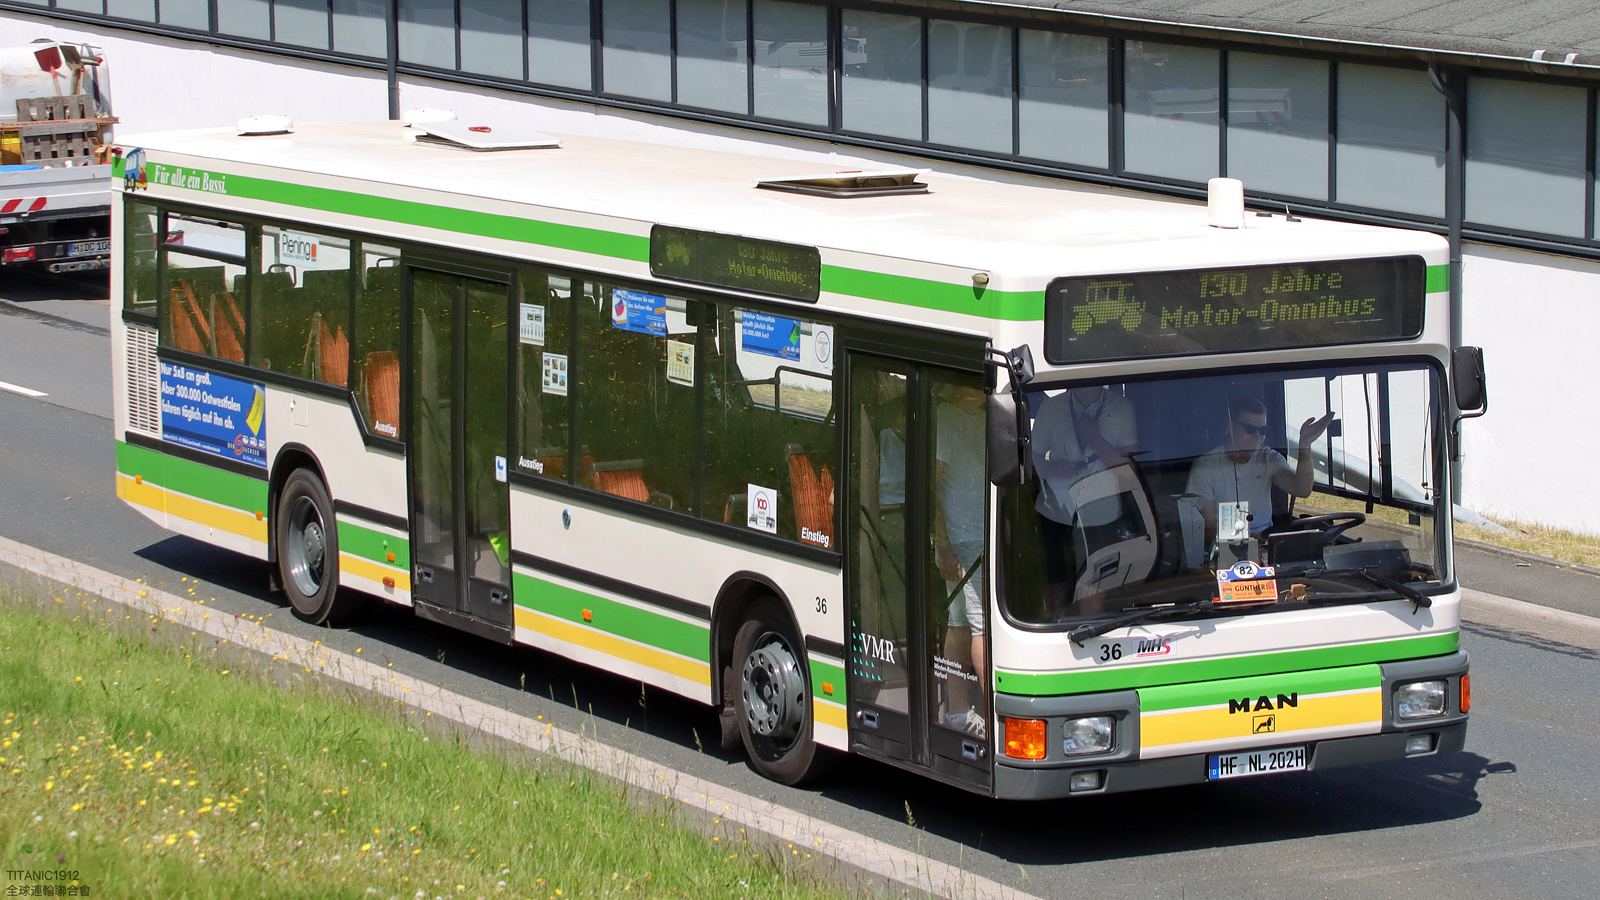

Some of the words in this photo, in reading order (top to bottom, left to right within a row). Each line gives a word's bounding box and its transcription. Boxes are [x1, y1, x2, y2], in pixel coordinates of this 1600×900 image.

[154, 165, 170, 184] Für
[171, 168, 186, 187] alle
[188, 170, 200, 189] ein
[202, 172, 226, 194] Bussi.
[1200, 273, 1248, 298] 130
[1262, 268, 1343, 294] Jahre
[1160, 295, 1376, 329] Motor-Omnibus
[160, 362, 172, 376] Nur
[173, 365, 185, 380] 5x8
[186, 371, 194, 382] cm
[196, 372, 212, 386] groß.
[161, 381, 176, 396] Aber
[176, 384, 200, 402] 300.000
[202, 390, 241, 412] Ostwestfalen
[162, 398, 181, 416] fahren
[182, 404, 201, 422] täglich
[202, 410, 213, 424] auf
[213, 412, 224, 426] ihn
[224, 416, 235, 430] ab.
[374, 420, 397, 438] Ausstieg
[518, 456, 544, 474] Ausstieg
[757, 498, 768, 510] 100
[801, 526, 830, 548] Einstieg
[1239, 566, 1253, 576] 82
[815, 596, 827, 614] 36
[860, 632, 896, 664] VMR
[1100, 642, 1122, 662] 36
[1138, 638, 1172, 654] MHS
[1228, 692, 1298, 714] MAN
[1220, 756, 1238, 775] HF
